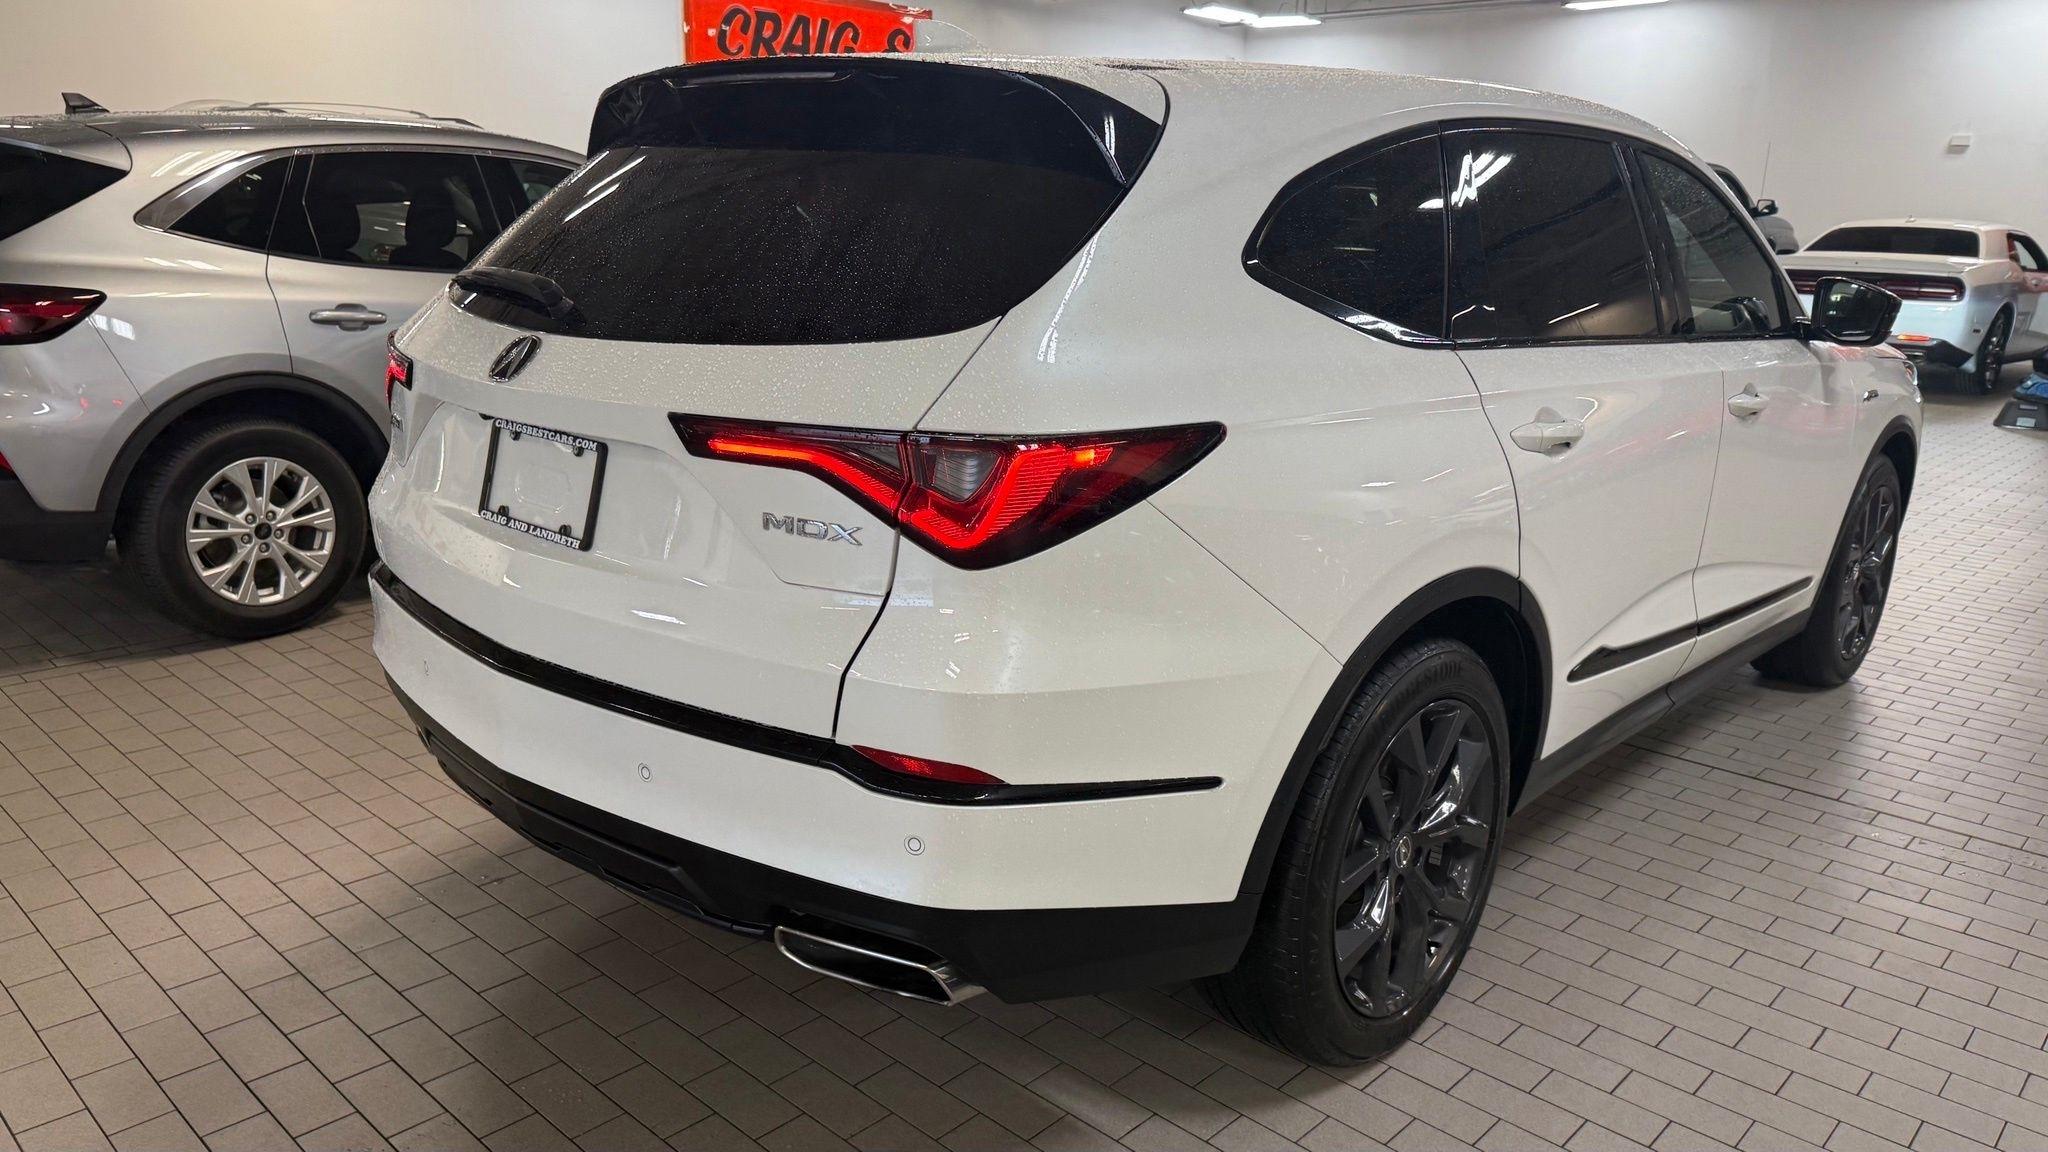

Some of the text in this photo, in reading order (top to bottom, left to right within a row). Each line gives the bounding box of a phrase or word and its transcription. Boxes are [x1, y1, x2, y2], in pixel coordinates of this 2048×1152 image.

[716, 6, 861, 57] CRAIG
[495, 418, 598, 451] CRAIGSBESTCARS.COM
[480, 509, 581, 549] CRAIG AND LANDRETH
[762, 511, 862, 545] MDX
